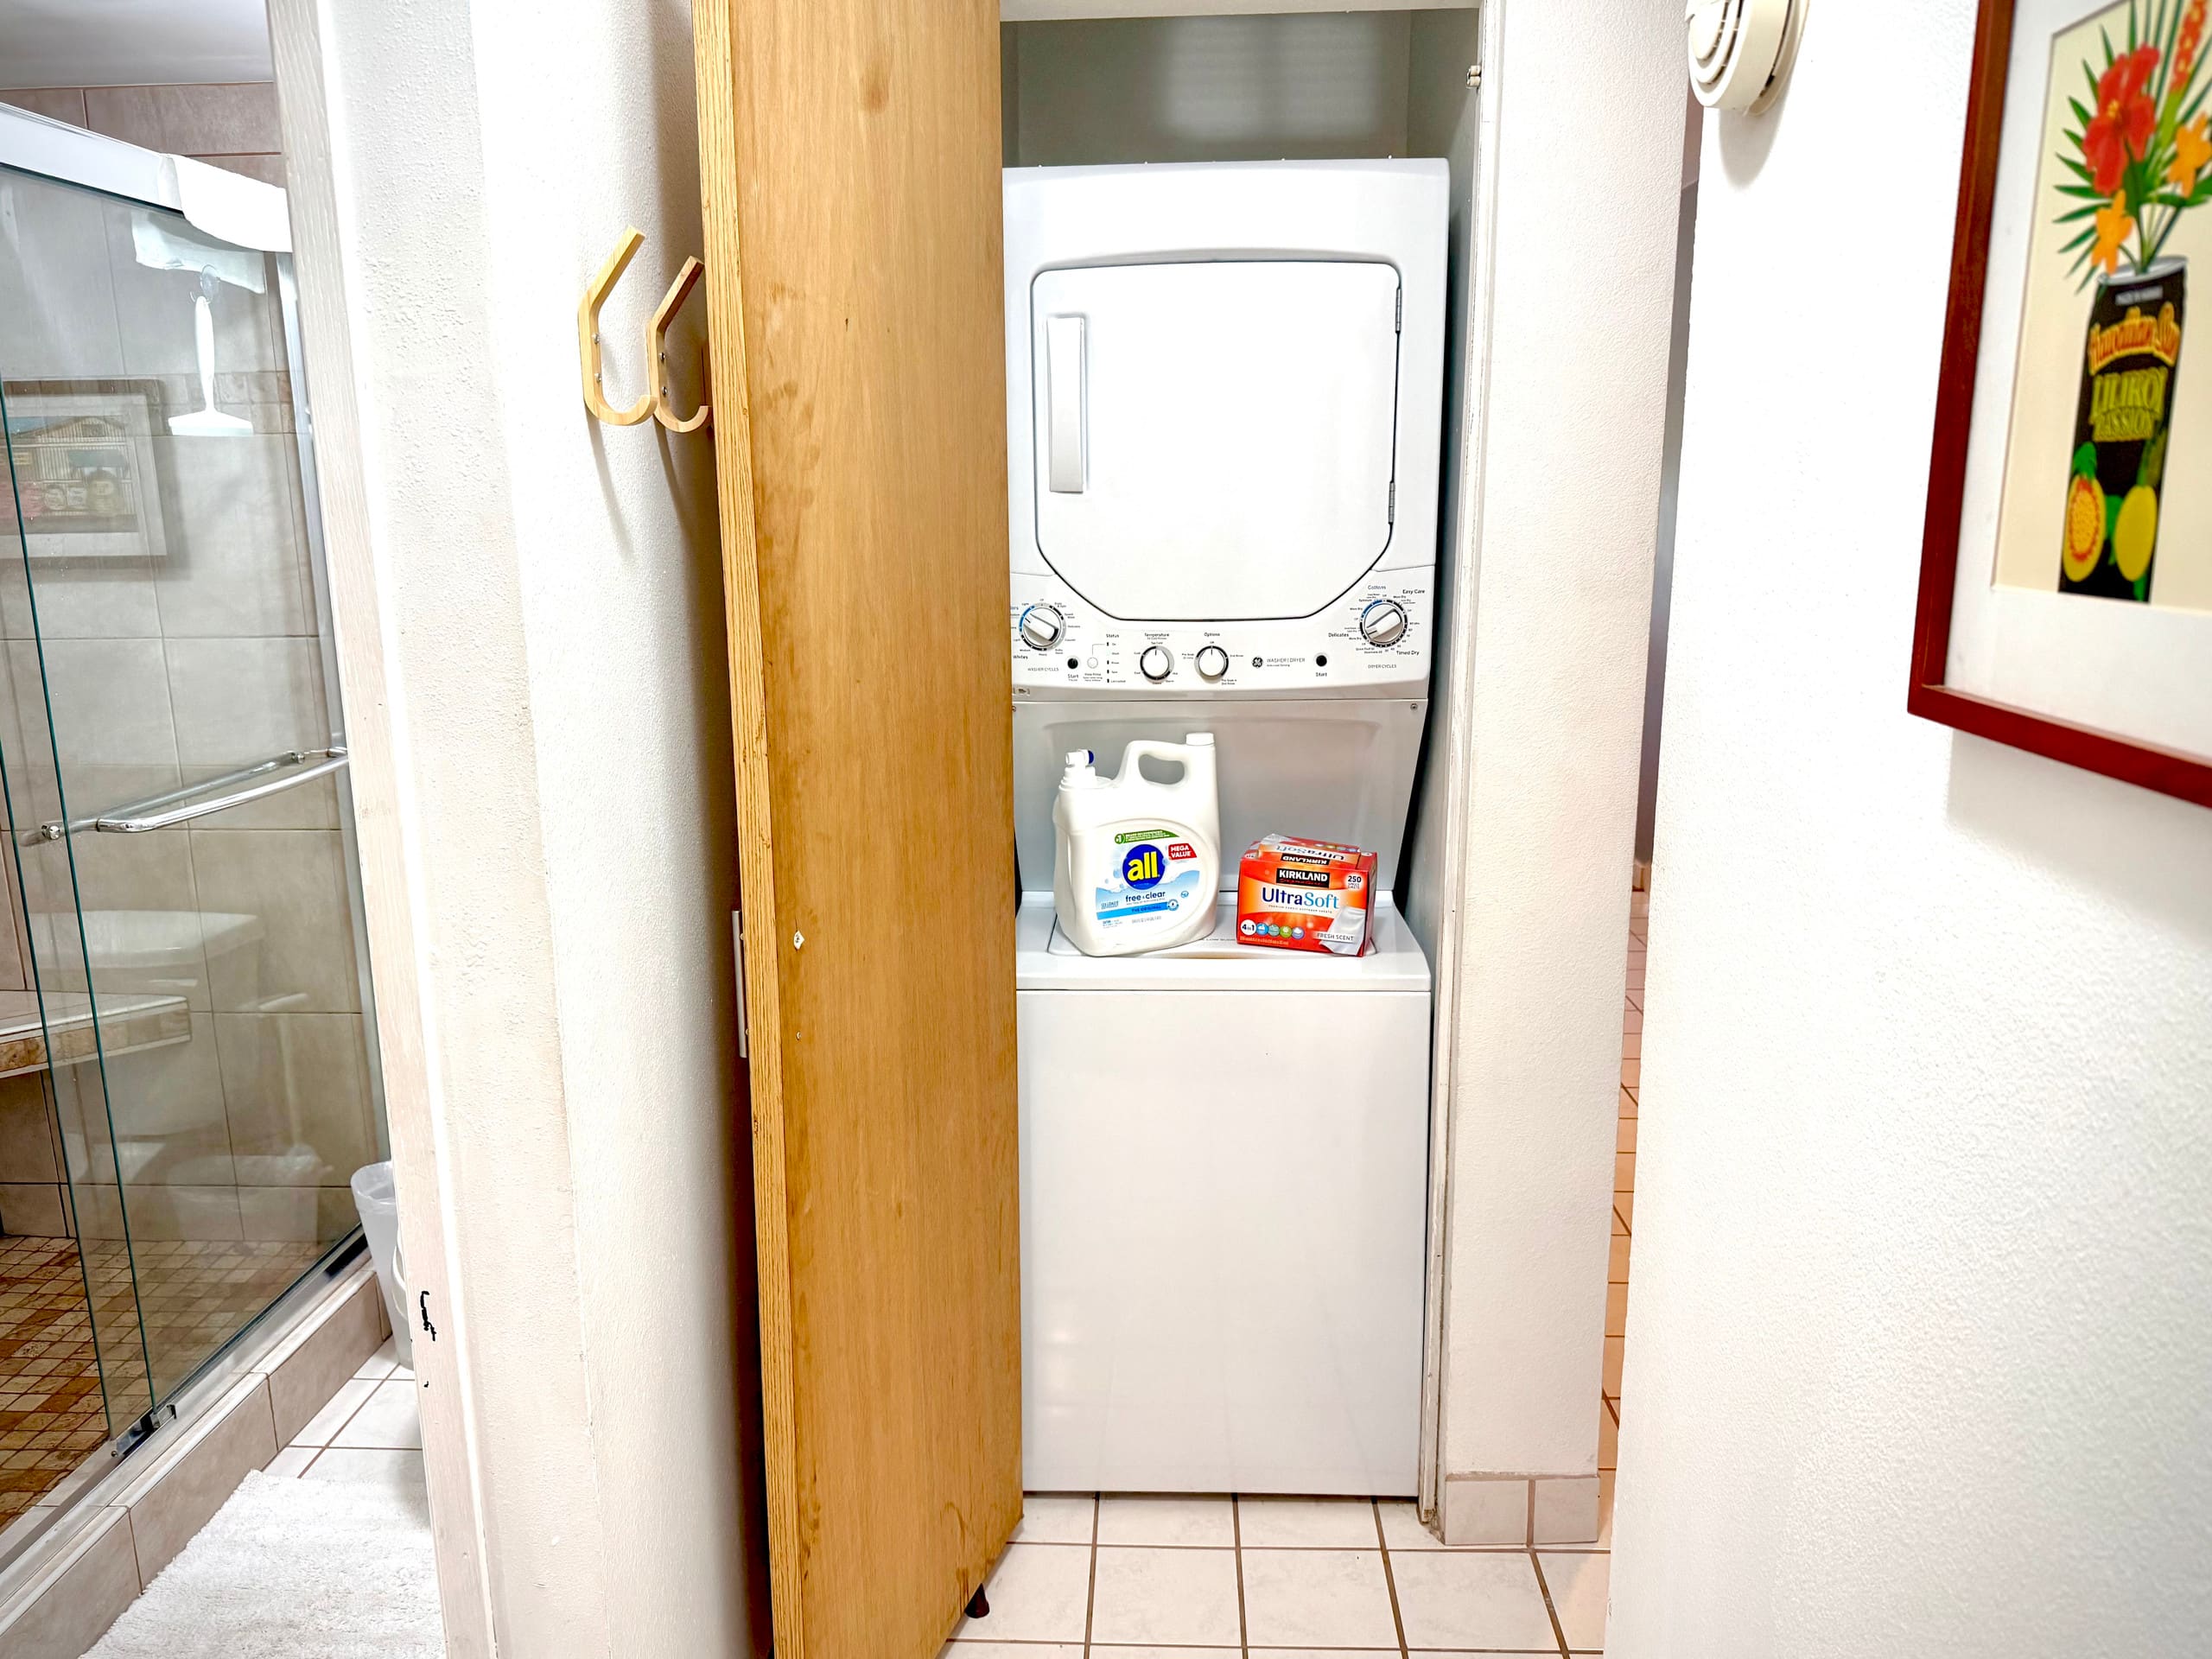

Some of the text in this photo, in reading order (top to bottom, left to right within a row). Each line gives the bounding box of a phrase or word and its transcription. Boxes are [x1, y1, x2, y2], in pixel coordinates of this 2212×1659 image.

[1127, 851, 1159, 881] all
[1282, 856, 1327, 865] KIRKLAND
[1279, 869, 1328, 881] KIRKLAND
[1262, 887, 1339, 909] UltraSoft
